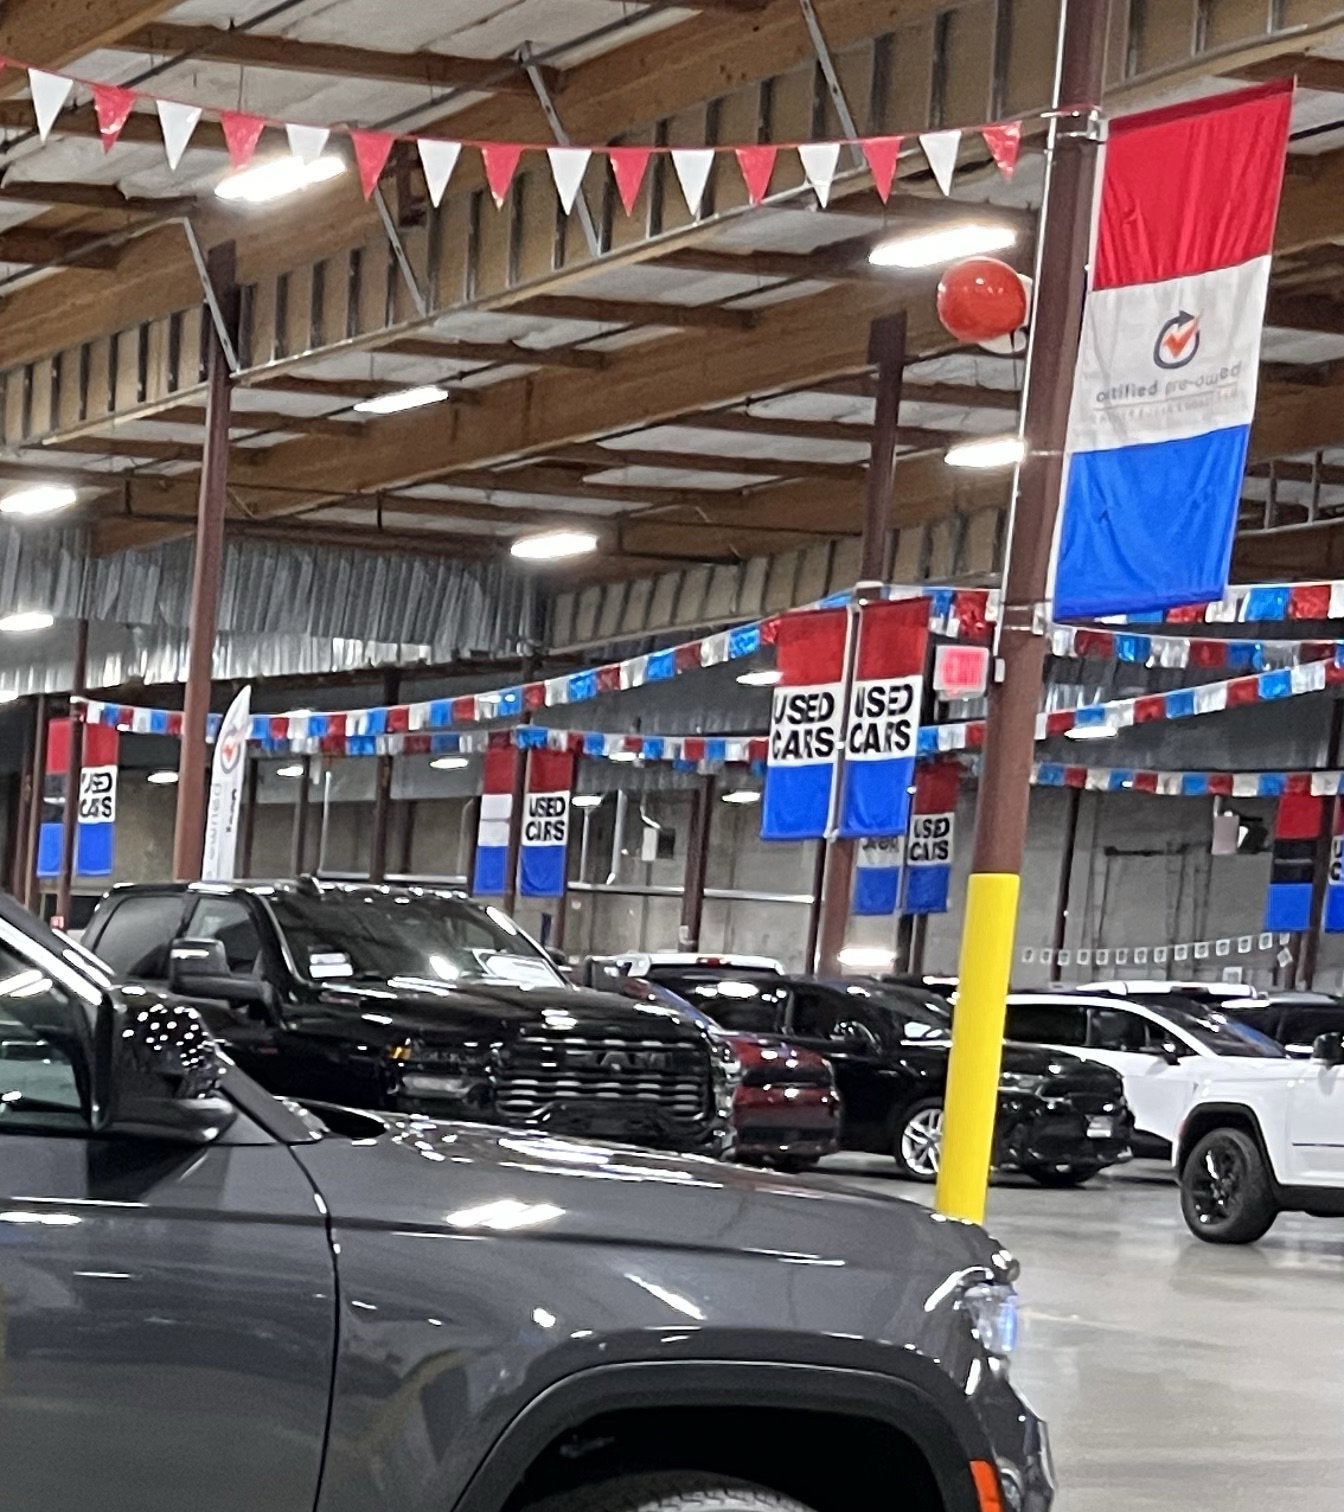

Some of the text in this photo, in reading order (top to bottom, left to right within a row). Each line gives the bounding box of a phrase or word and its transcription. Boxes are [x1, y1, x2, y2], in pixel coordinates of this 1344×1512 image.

[774, 692, 835, 725] USED
[855, 684, 914, 718] USED
[773, 727, 835, 759] CARS
[849, 719, 912, 754] CARS
[528, 796, 566, 818] USED
